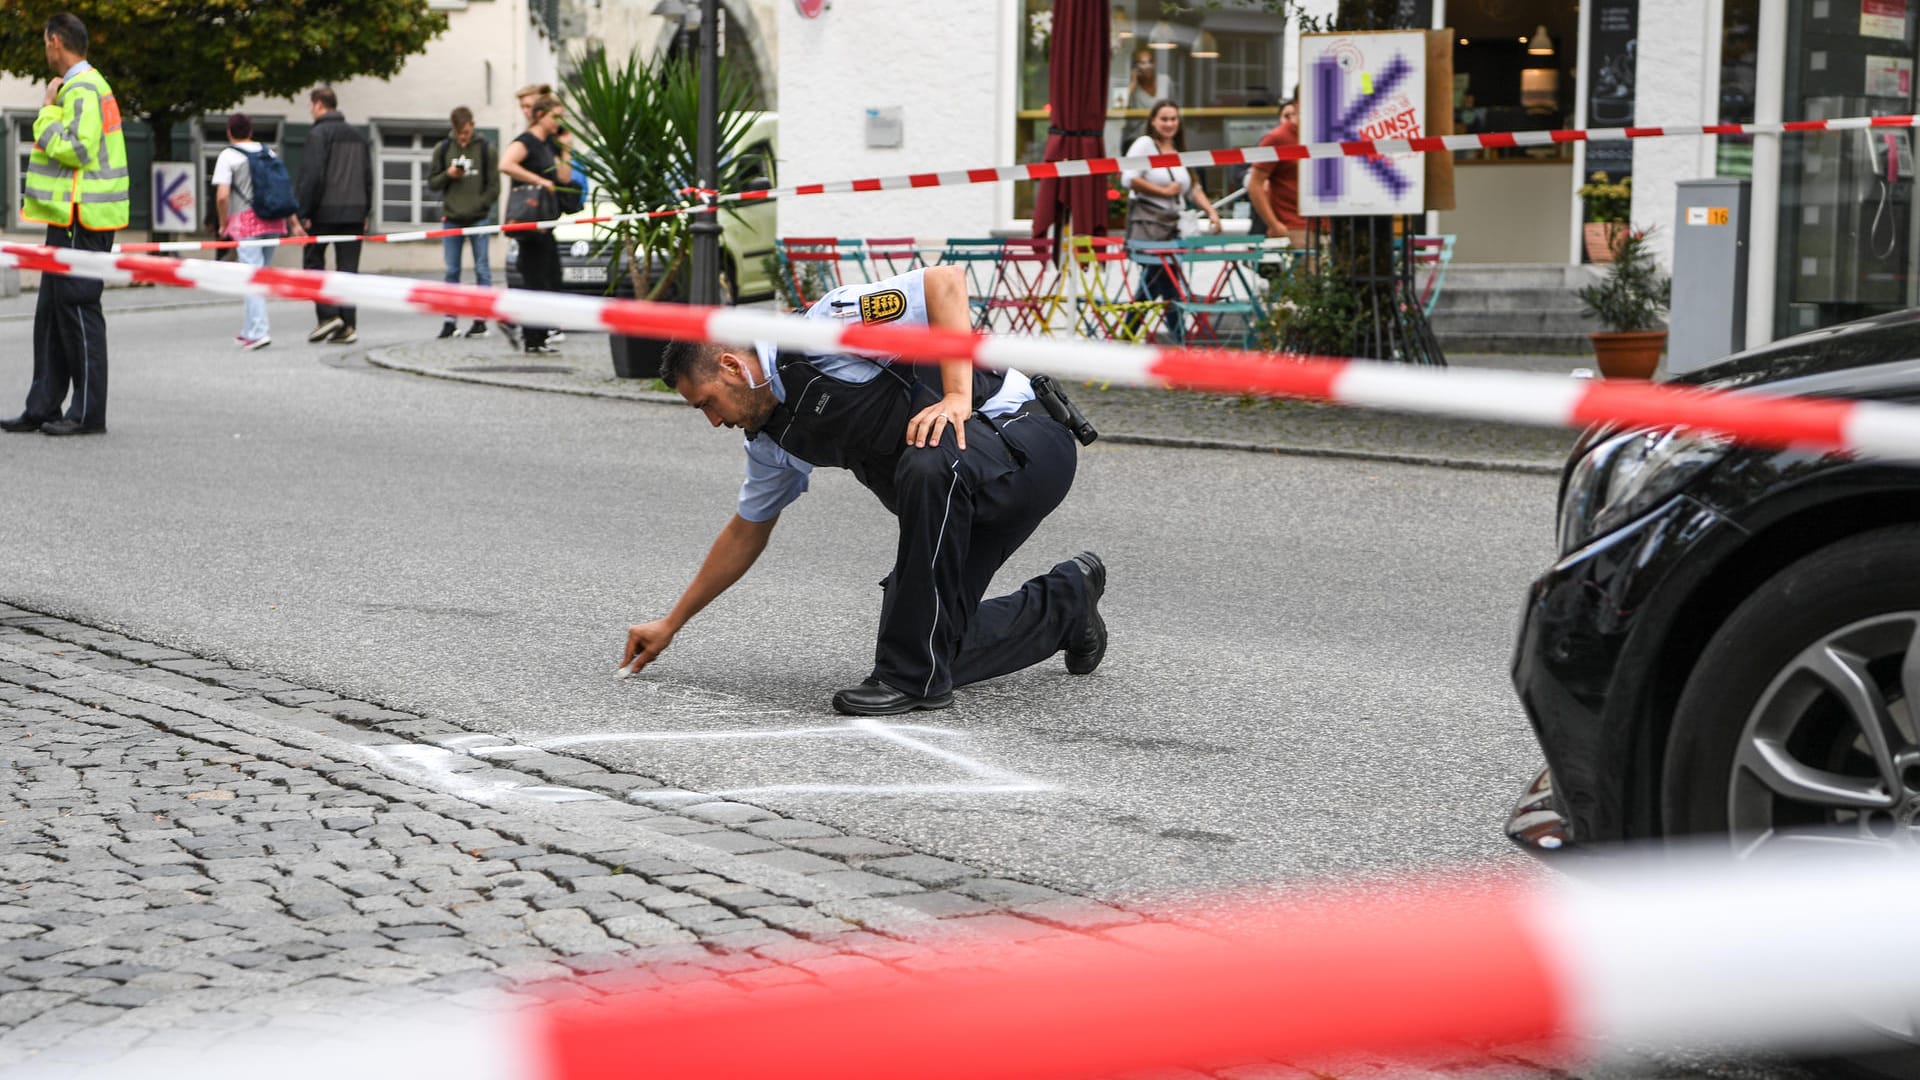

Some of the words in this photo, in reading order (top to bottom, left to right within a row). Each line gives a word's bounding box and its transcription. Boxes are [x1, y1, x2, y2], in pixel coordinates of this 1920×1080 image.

[1311, 53, 1411, 203] K
[1358, 107, 1415, 142] KUNST
[155, 169, 188, 225] K
[1713, 210, 1728, 225] 16
